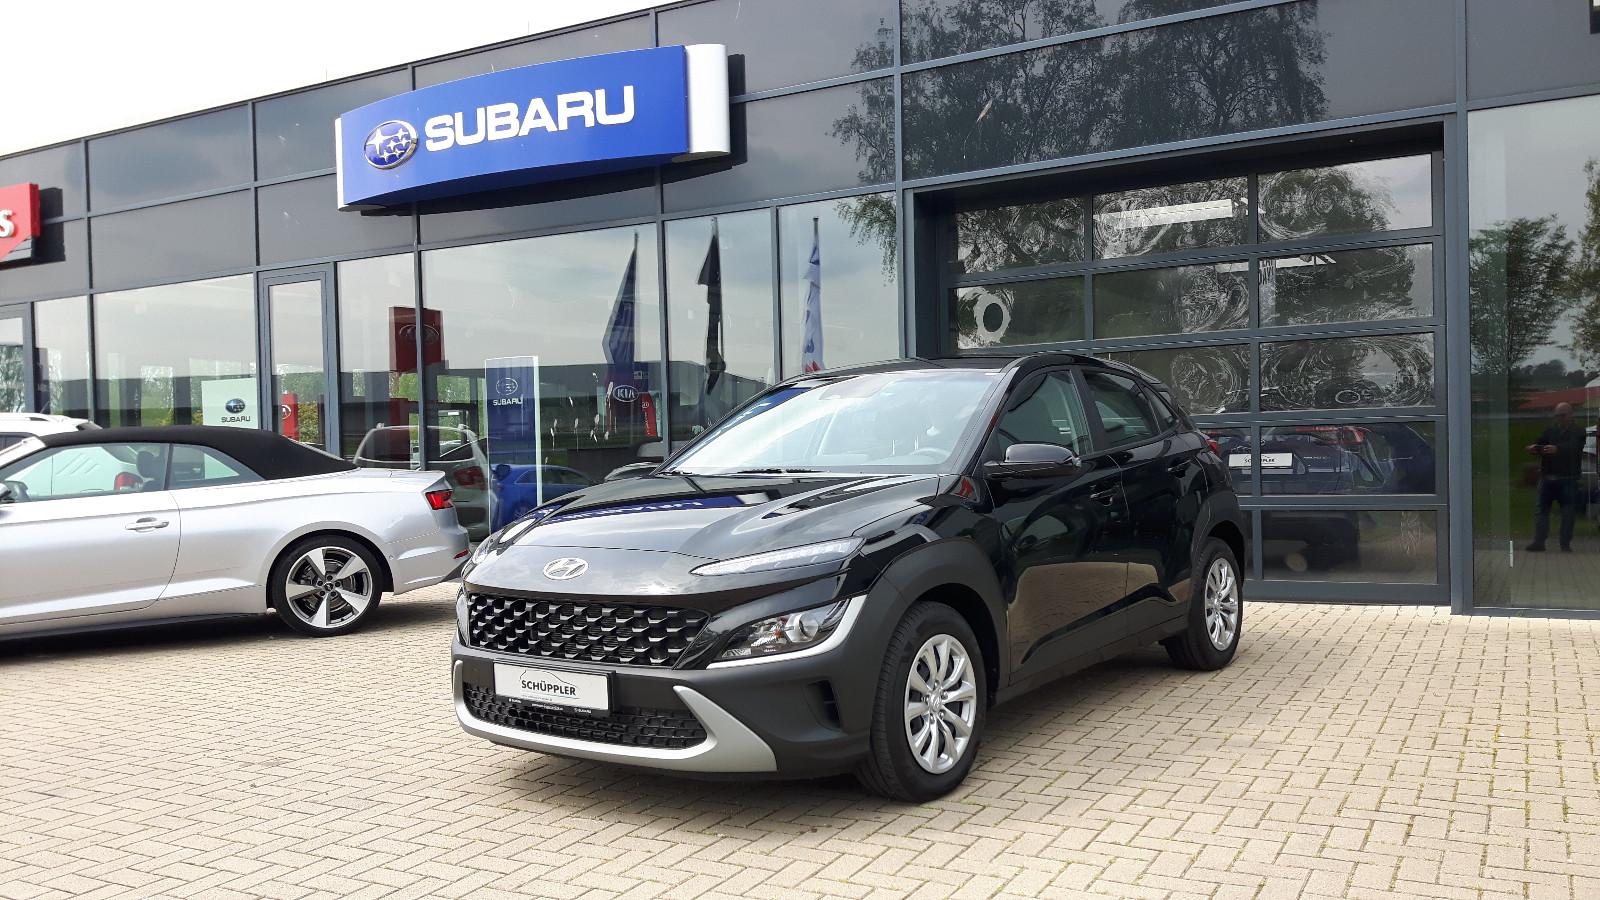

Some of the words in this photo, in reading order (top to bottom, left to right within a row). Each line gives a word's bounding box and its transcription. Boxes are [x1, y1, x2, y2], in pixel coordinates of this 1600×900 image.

[425, 85, 635, 152] SUBARU
[617, 388, 636, 399] KIA
[493, 397, 523, 406] SUBARU
[521, 680, 577, 696] SCHÜPPLER
